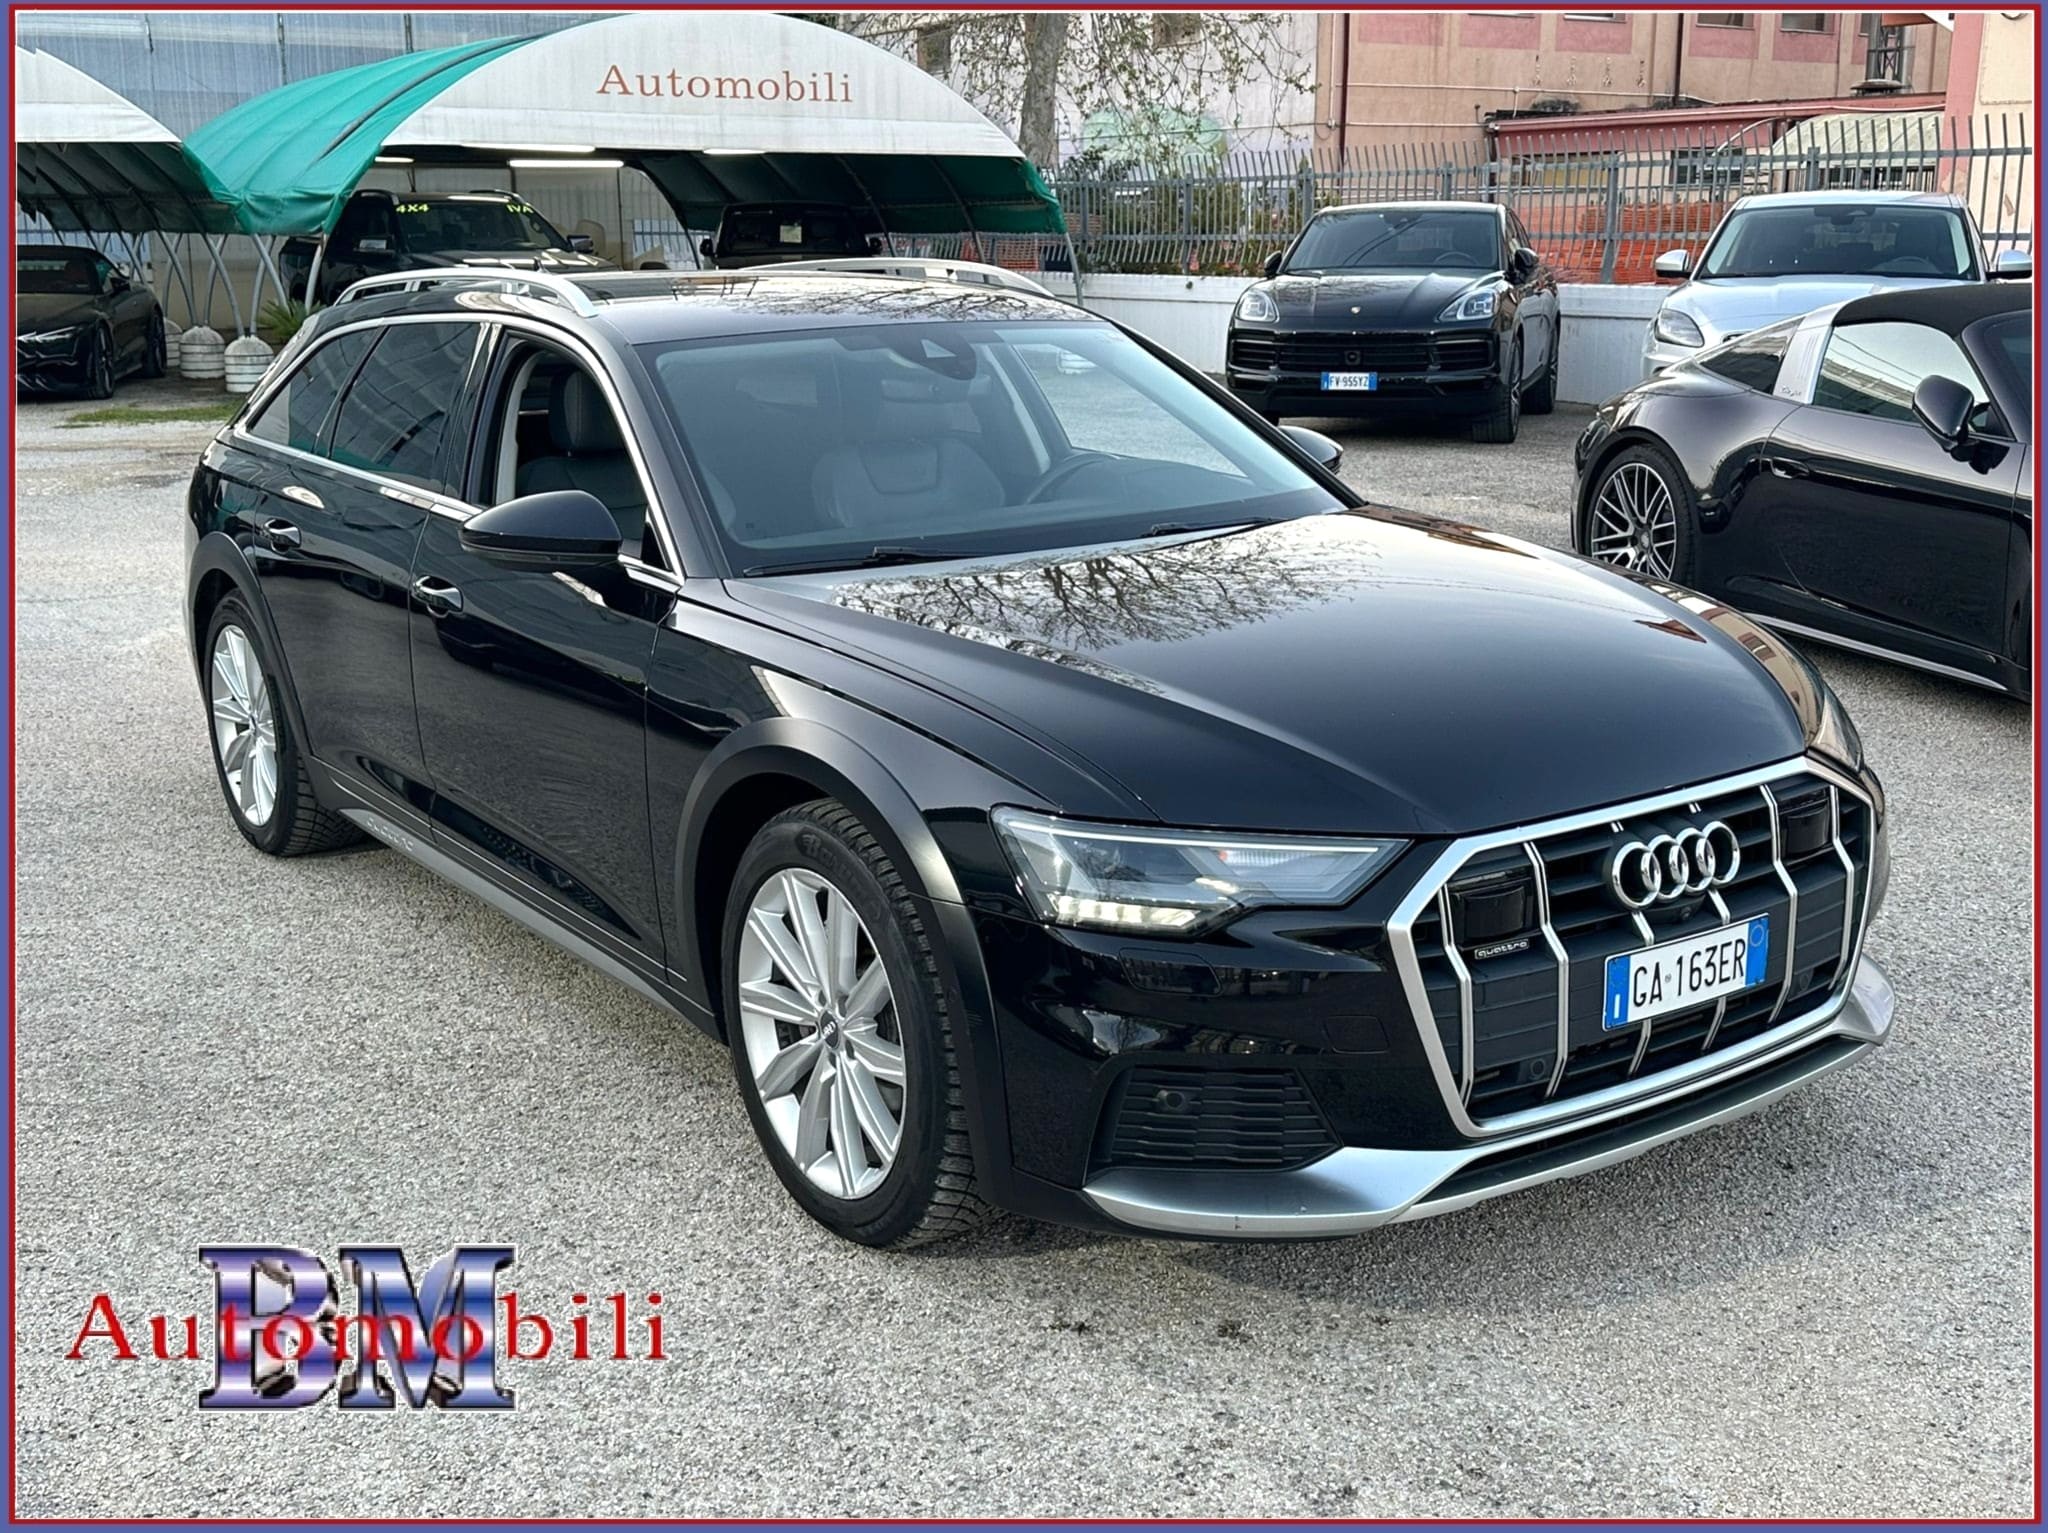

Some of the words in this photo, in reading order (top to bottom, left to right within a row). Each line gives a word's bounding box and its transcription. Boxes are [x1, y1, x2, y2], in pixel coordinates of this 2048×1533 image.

[596, 63, 853, 103] Automobili
[1478, 941, 1527, 959] quattro
[1632, 961, 1663, 1007] GA
[1676, 938, 1746, 997] 163ER
